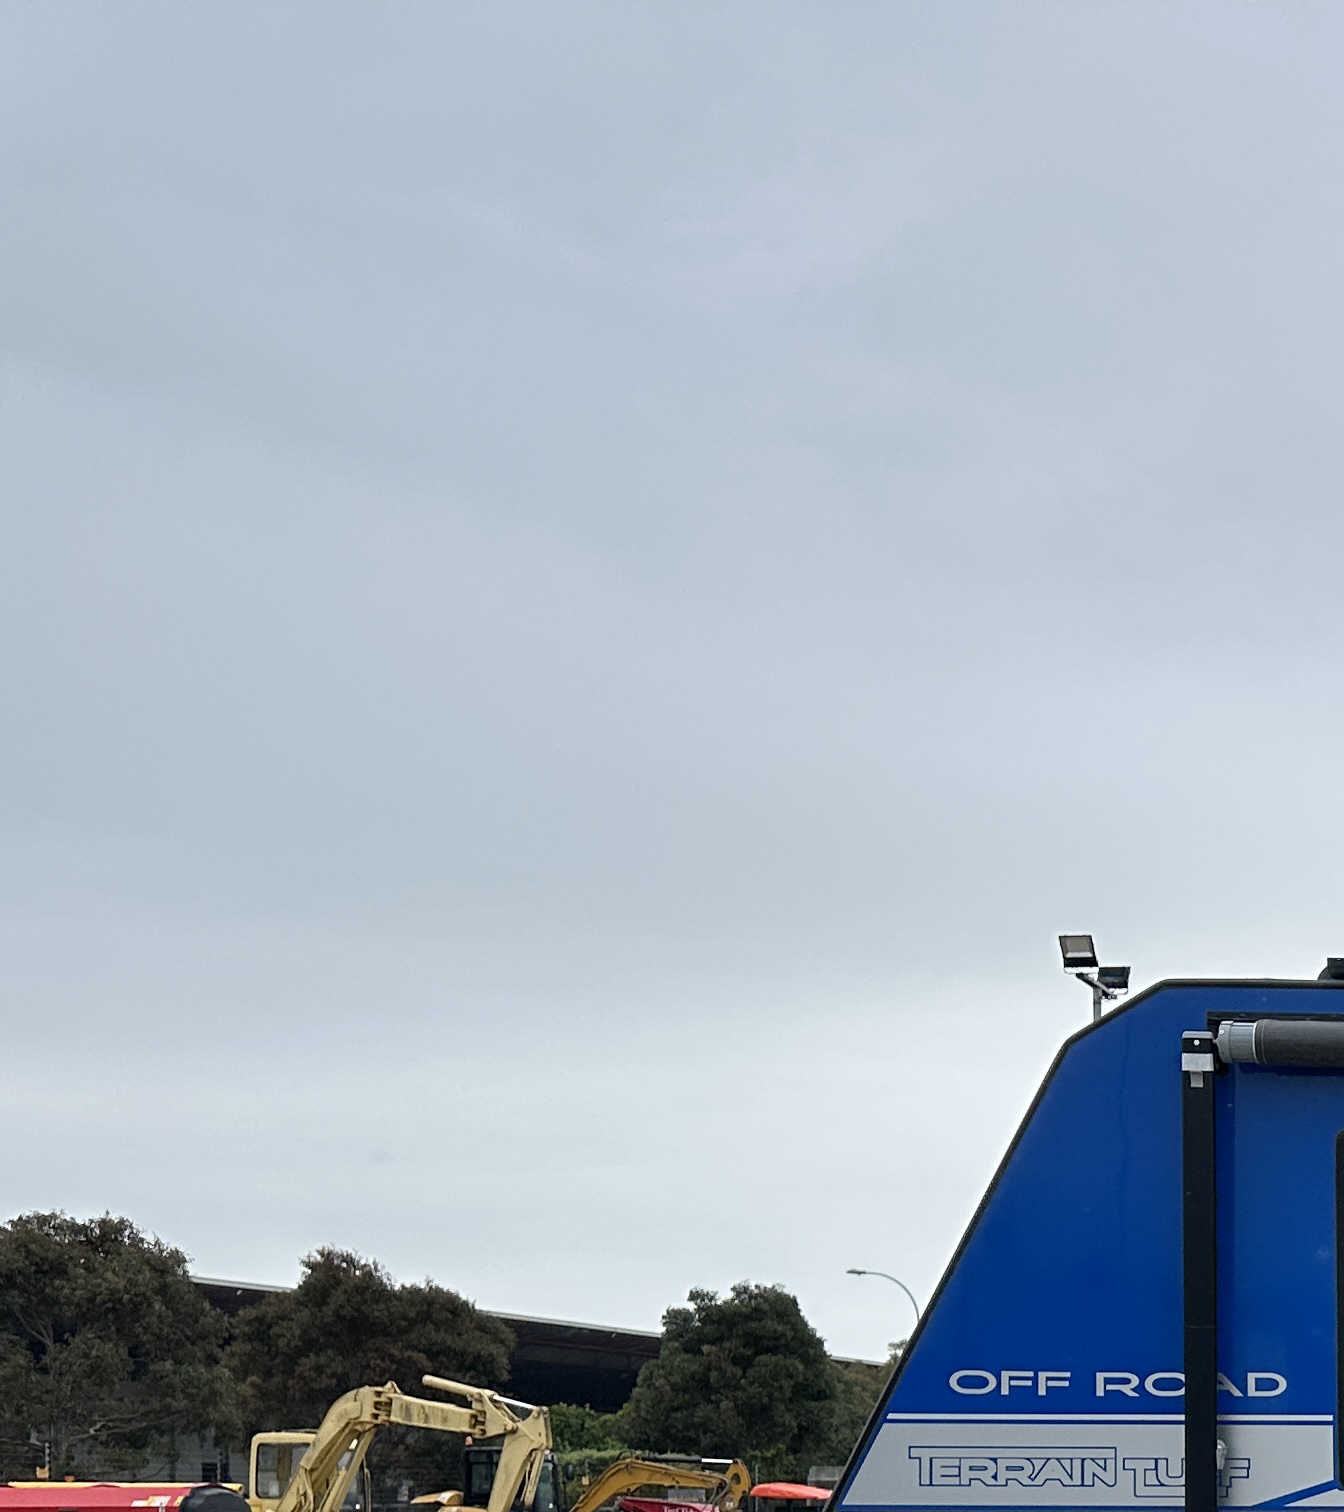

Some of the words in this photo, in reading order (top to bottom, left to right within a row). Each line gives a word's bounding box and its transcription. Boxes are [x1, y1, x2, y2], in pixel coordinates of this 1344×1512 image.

[948, 1369, 1071, 1396] OFF
[908, 1445, 1117, 1488] TERRAIN
[1123, 1457, 1251, 1498] TUF
